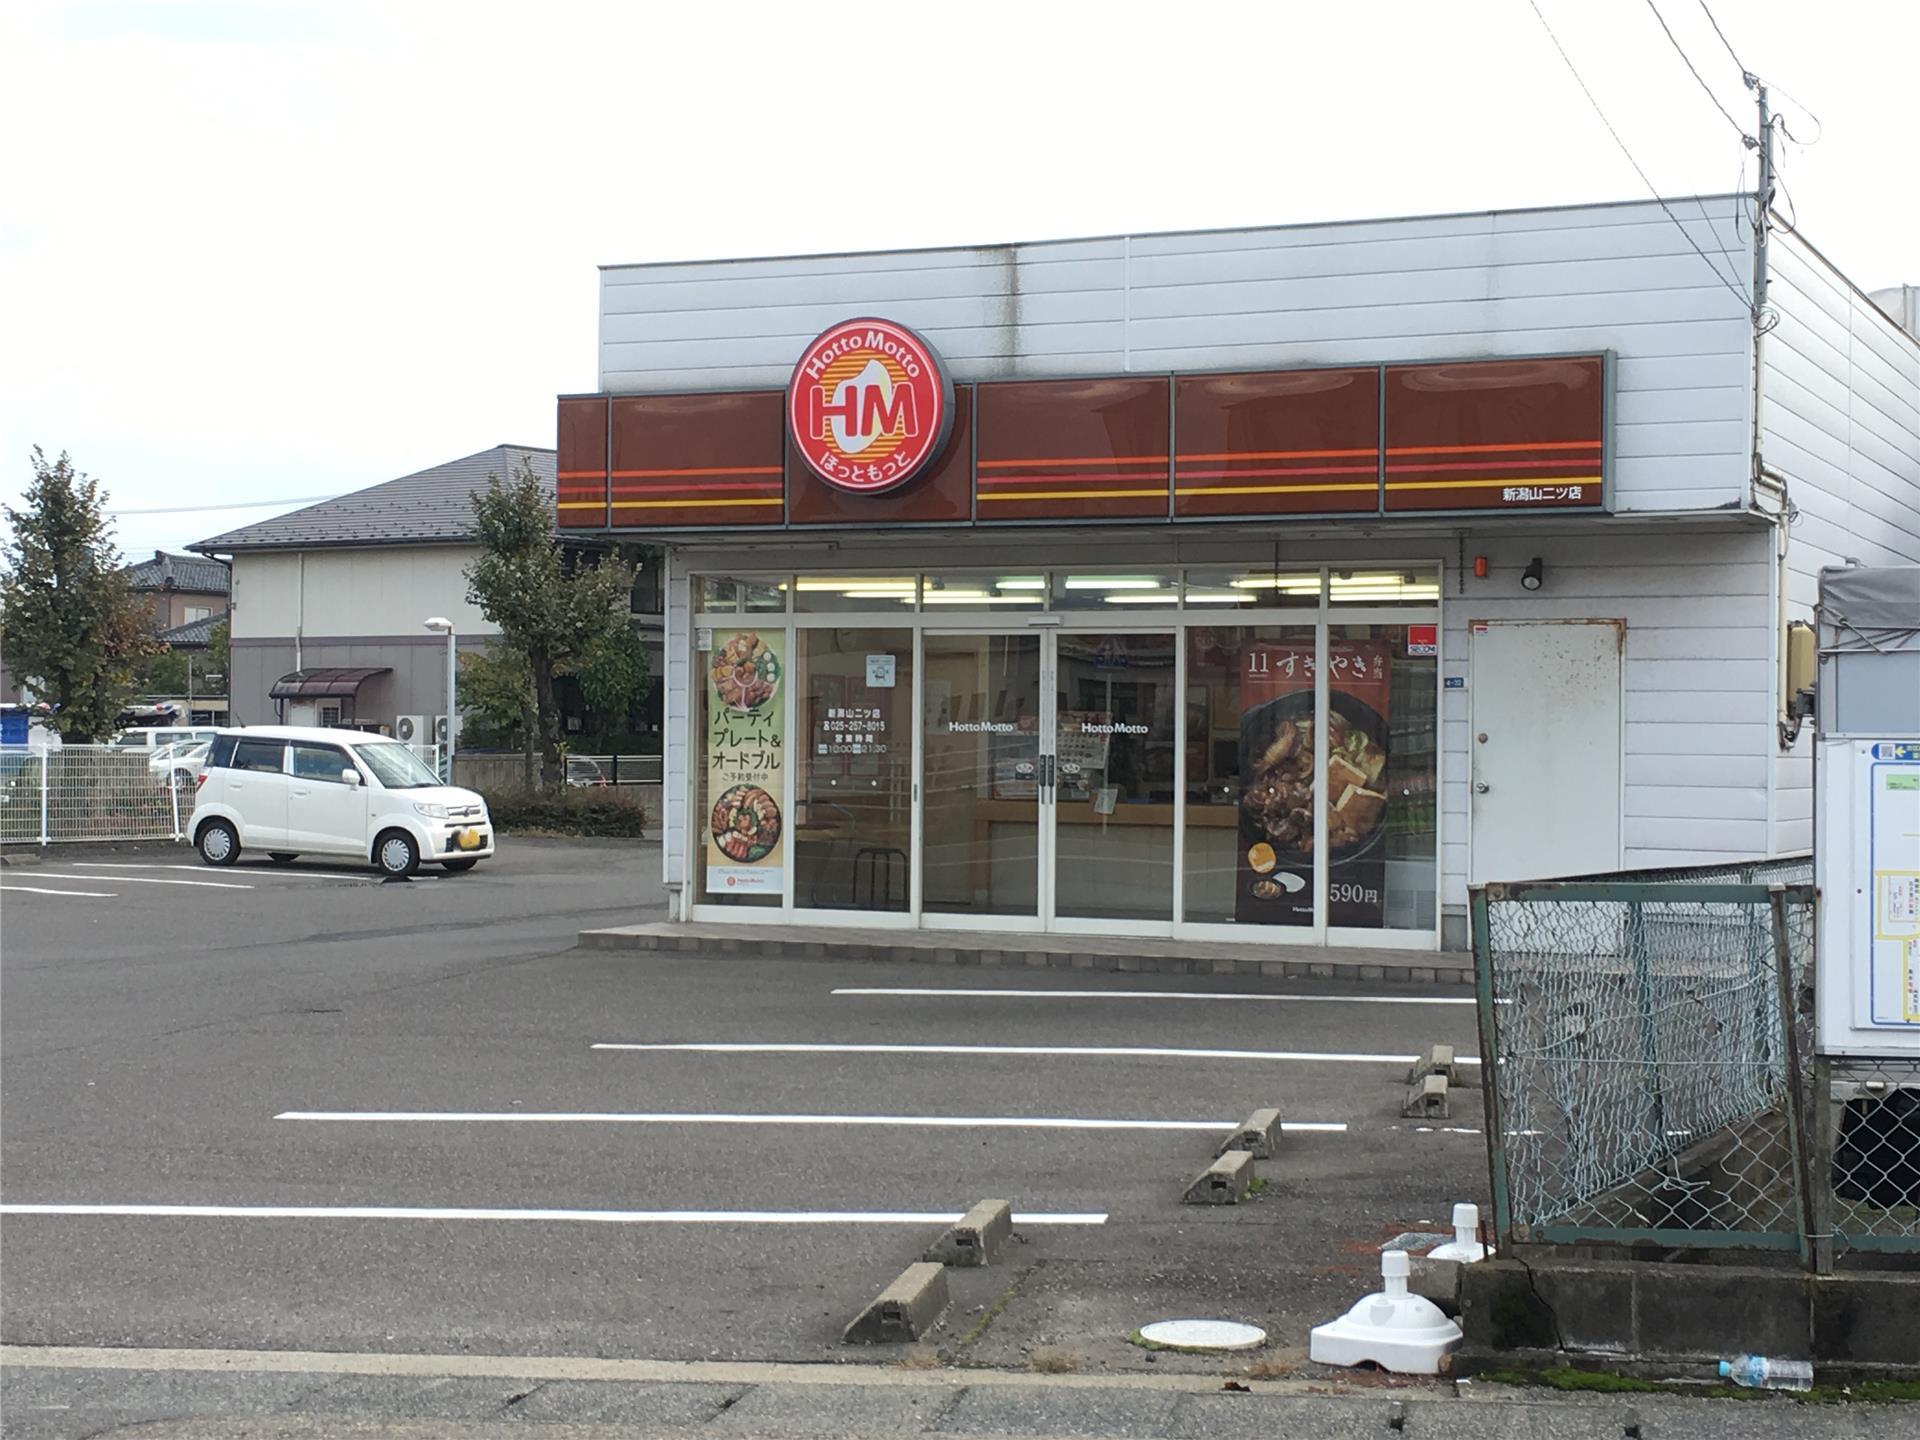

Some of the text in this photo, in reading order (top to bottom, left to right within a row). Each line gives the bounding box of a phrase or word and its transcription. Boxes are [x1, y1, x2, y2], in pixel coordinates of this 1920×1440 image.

[810, 382, 919, 440] HM
[819, 451, 911, 482] ほっともっと
[1248, 653, 1269, 672] 11
[1276, 652, 1366, 678] すきやき
[714, 708, 775, 727] パーティ
[713, 729, 782, 748] プレート&
[712, 751, 780, 770] オードブル
[1329, 884, 1378, 903] 590円
